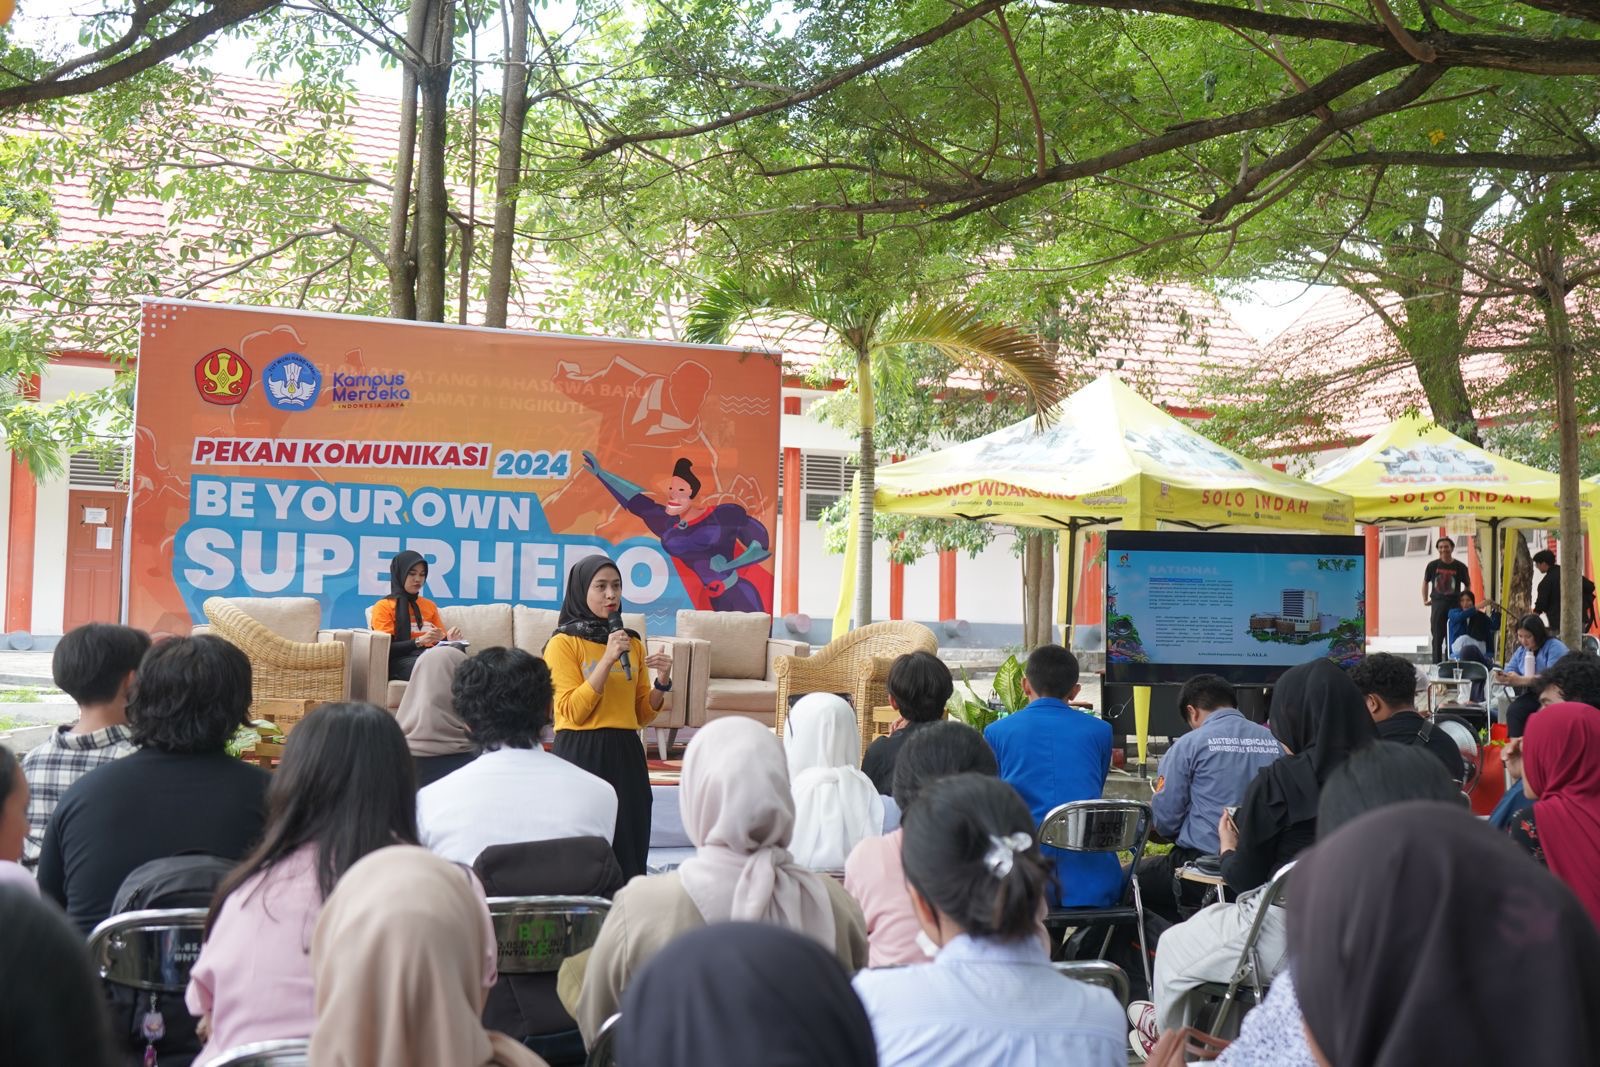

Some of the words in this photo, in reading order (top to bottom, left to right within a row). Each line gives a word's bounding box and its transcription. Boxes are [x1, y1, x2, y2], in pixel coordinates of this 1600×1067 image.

[333, 372, 405, 389] Kampus
[332, 386, 410, 402] Merdeka
[195, 441, 297, 463] PEKAN
[301, 443, 488, 466] KOMUNIKASI
[497, 453, 568, 476] 2024
[195, 480, 256, 518] BE
[265, 484, 403, 526] YOUR
[411, 492, 531, 531] OWN
[1202, 489, 1245, 508] SOLO
[1255, 495, 1309, 514] INDAH
[1389, 491, 1446, 504] SOLO
[1459, 491, 1533, 504] INDAH
[1208, 744, 1245, 754] UNIVERSITAS
[1246, 746, 1279, 754] TADULAKO
